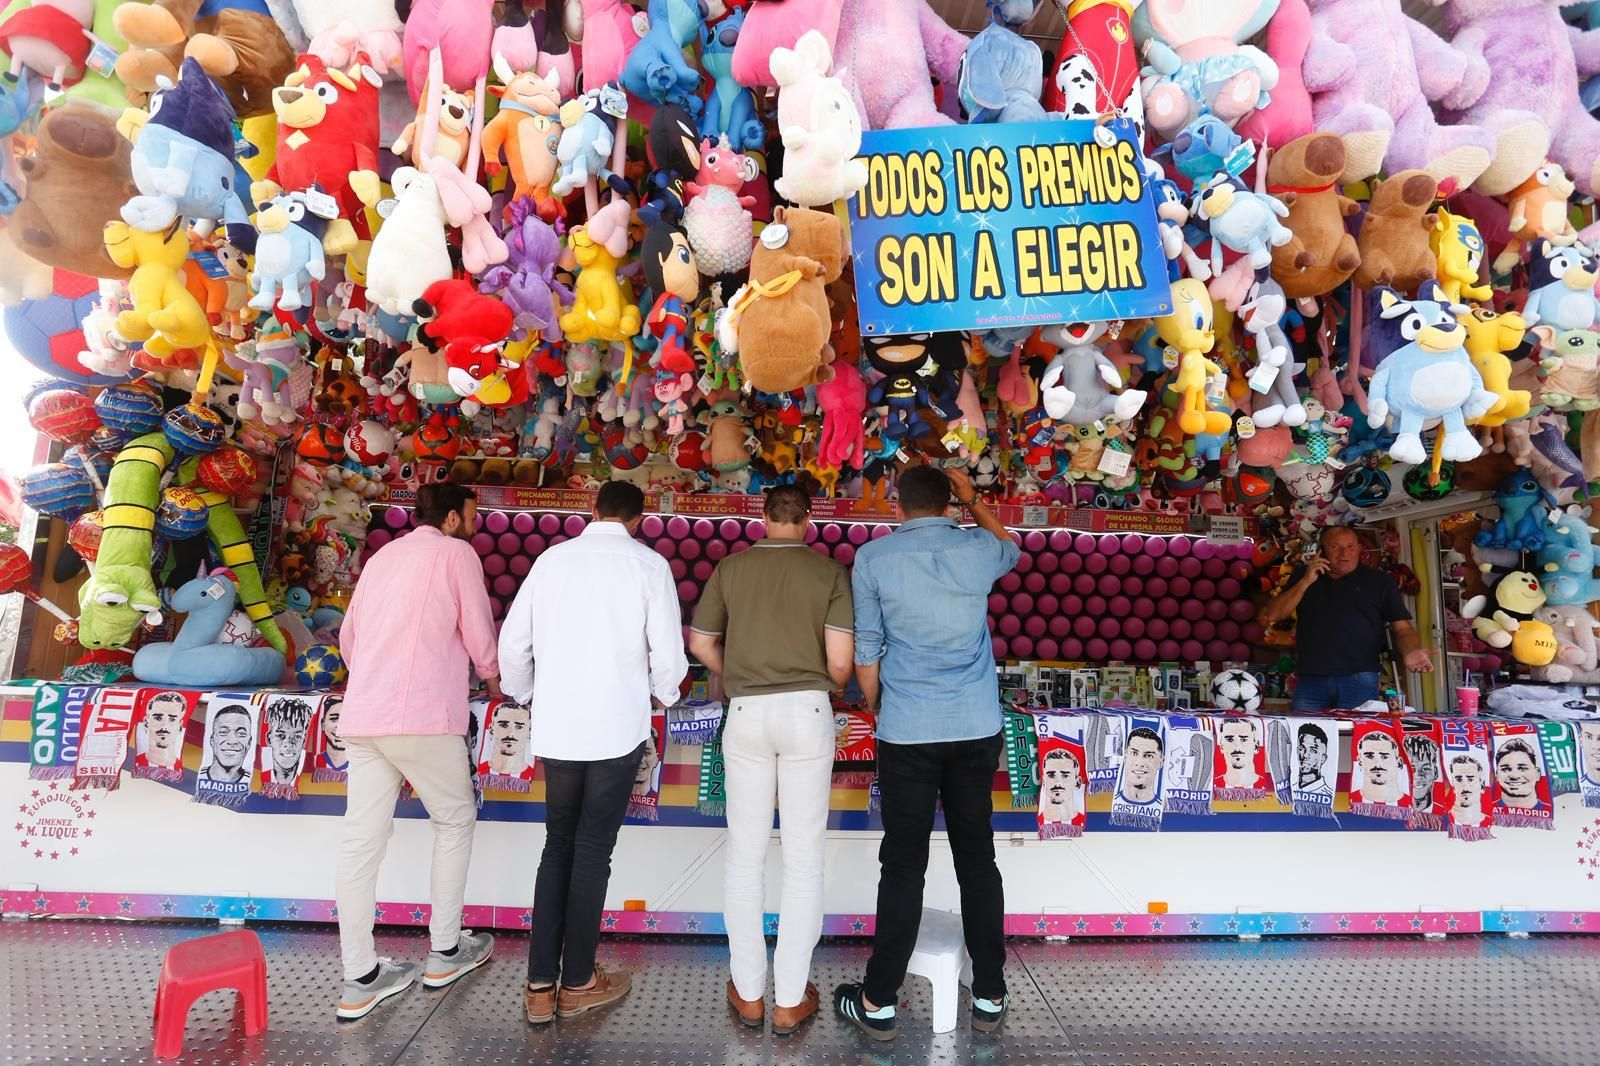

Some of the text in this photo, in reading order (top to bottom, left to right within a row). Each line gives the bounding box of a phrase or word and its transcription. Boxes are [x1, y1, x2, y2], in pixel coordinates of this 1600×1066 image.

[856, 140, 1142, 218] TODOS LOS PREMIOS
[878, 222, 1144, 306] SON A ELEGIR
[391, 490, 417, 499] DARDOS
[516, 490, 556, 499] PINCHANDO
[676, 496, 727, 504] REGLAS
[1105, 513, 1148, 523] PINCHANDO
[1156, 516, 1185, 524] GLOBOS
[94, 690, 134, 733] LLA
[34, 685, 59, 764] ANO
[200, 780, 248, 793] MADRID
[27, 793, 85, 819] EUROJUEGOS
[1112, 803, 1161, 818] CRISTIANO
[1508, 809, 1550, 818] MADRID
[36, 818, 73, 827] JIMENEZ
[26, 826, 79, 839] M. LUQUE
